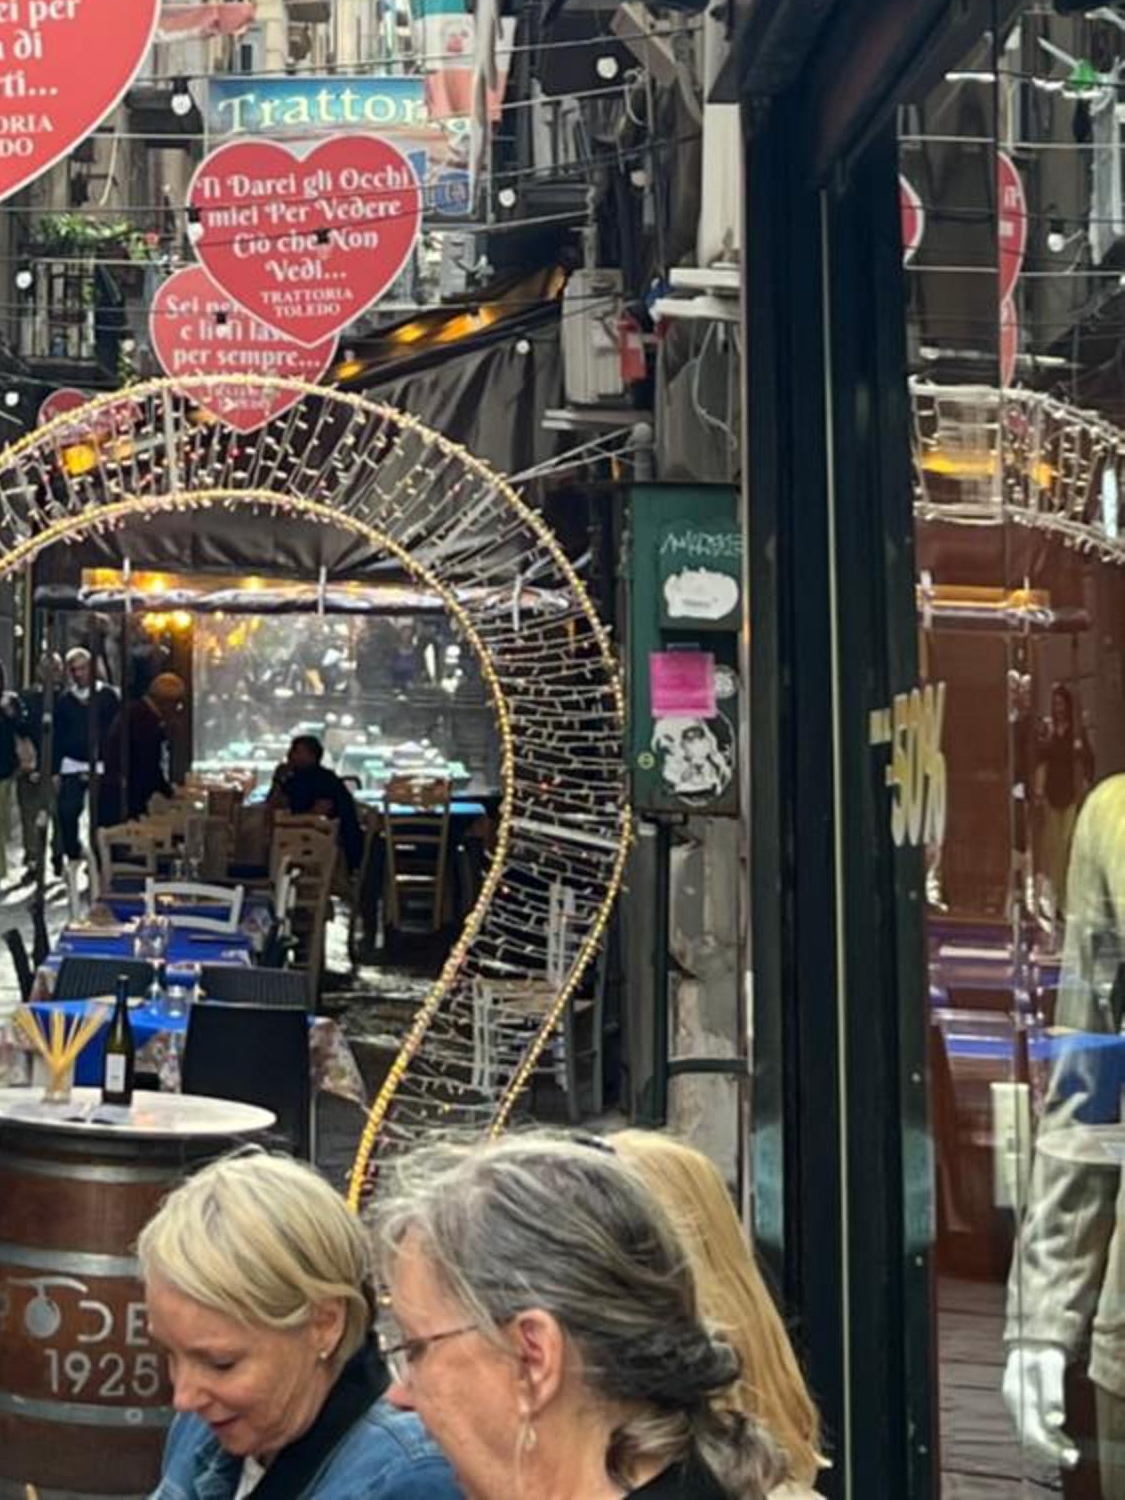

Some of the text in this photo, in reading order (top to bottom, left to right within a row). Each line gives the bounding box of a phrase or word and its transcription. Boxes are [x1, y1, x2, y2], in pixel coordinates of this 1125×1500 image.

[14, 30, 43, 60] di
[218, 86, 428, 134] Trattor
[226, 173, 297, 197] Darei
[303, 168, 332, 199] gli
[339, 165, 409, 190] Occhi
[208, 195, 402, 228] miei Per Vedere
[277, 229, 317, 252] che
[327, 228, 379, 252] Non
[165, 294, 200, 319] Sei
[261, 287, 354, 305] TRATTORIA
[274, 302, 341, 318] TOLEDO
[172, 349, 321, 372] per sempre...
[43, 1348, 160, 1397] 1925
